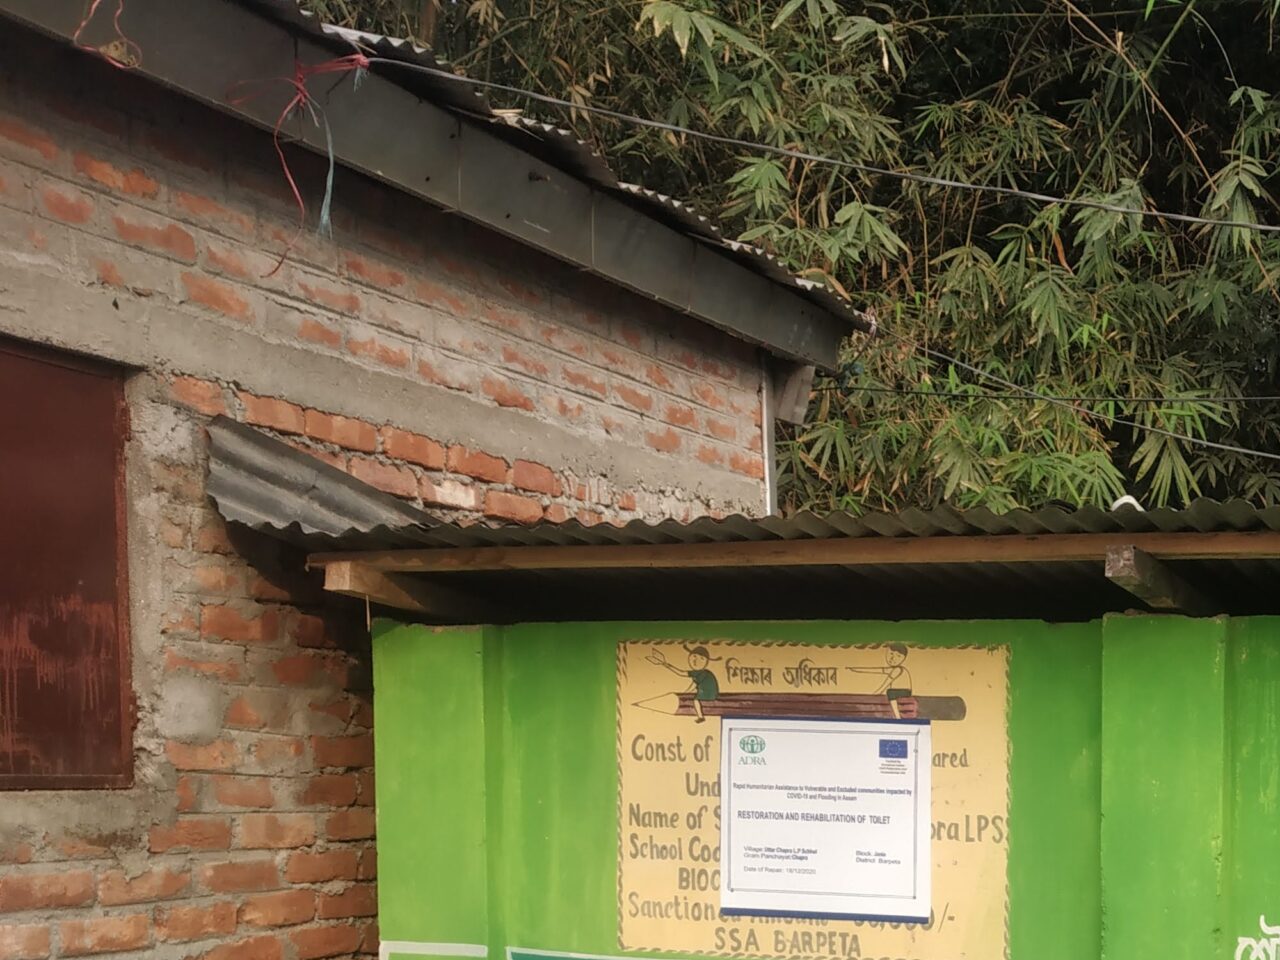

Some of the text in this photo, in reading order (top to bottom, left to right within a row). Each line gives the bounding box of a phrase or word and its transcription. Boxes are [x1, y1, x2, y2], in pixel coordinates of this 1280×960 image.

[631, 734, 713, 762] Const of
[738, 756, 767, 766] ADRA
[629, 802, 679, 828] Name
[686, 805, 708, 830] of
[737, 810, 890, 824] RESTORATION AND REHABILITATION OF TOILET
[629, 832, 683, 860] School
[715, 926, 760, 952] SSA
